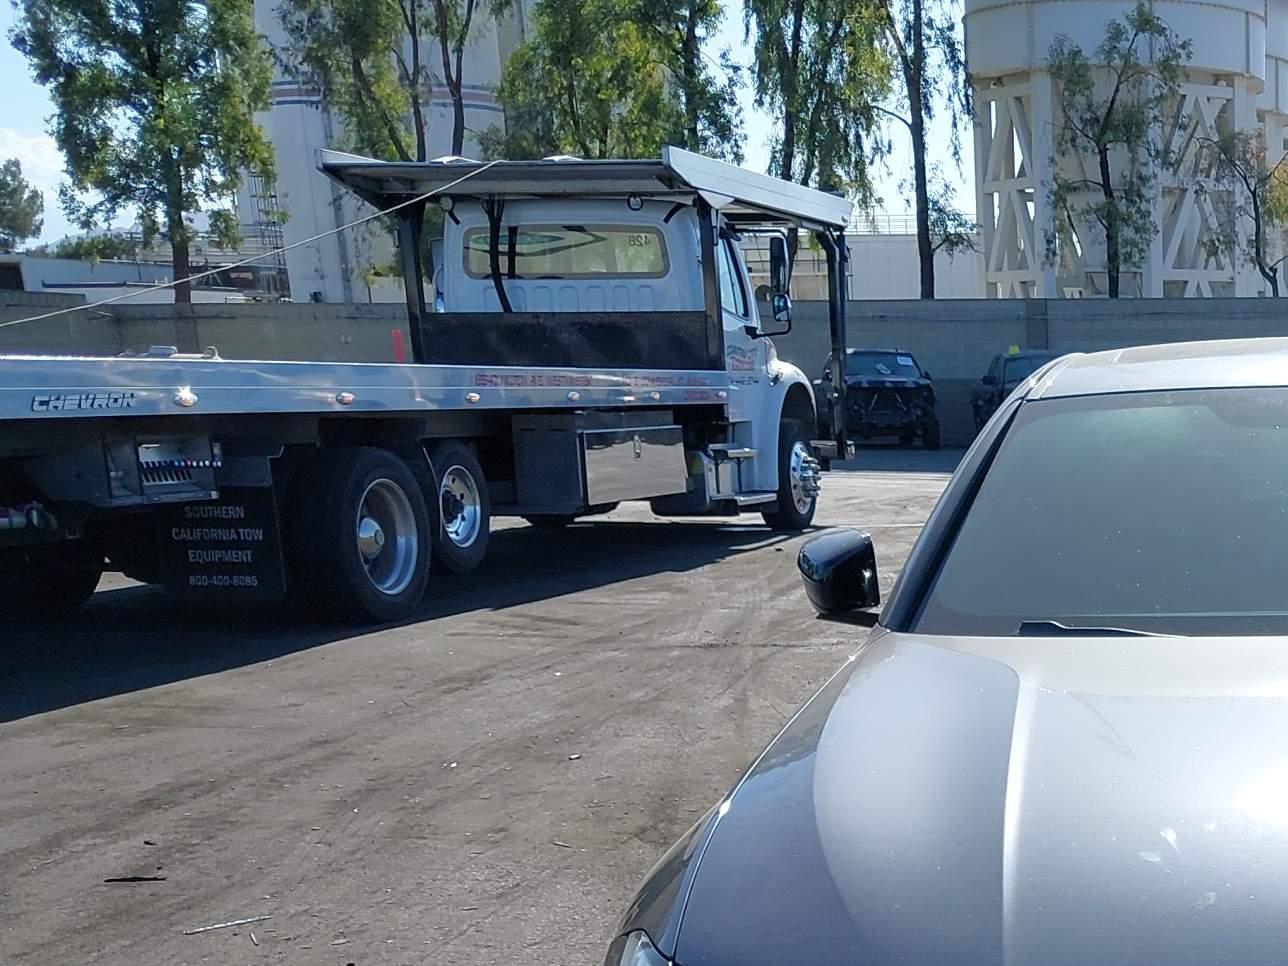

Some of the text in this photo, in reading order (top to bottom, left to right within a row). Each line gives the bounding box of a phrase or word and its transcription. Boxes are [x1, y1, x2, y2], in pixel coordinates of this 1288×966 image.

[32, 391, 137, 412] CHEVRON
[184, 505, 245, 519] SOUTHERN
[171, 528, 263, 541] CALIFORNIA TOW
[188, 550, 253, 563] EQUIPMENT
